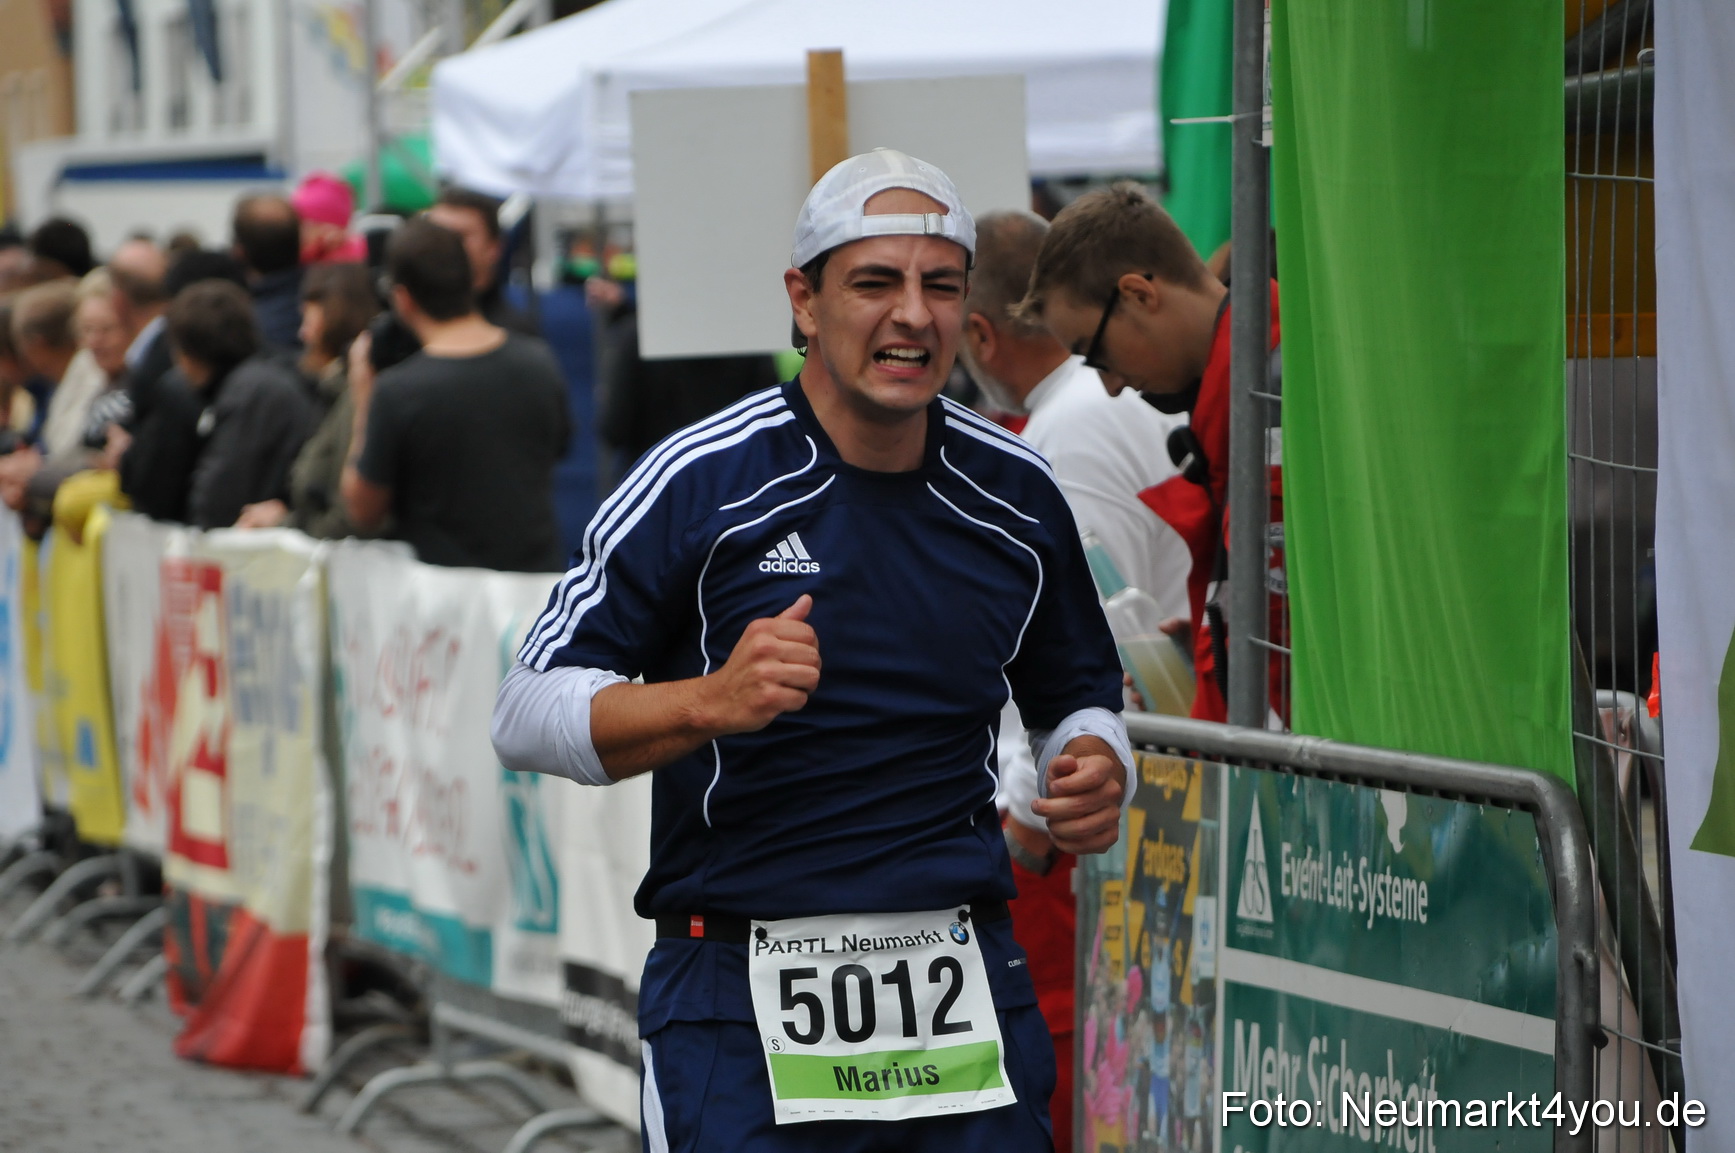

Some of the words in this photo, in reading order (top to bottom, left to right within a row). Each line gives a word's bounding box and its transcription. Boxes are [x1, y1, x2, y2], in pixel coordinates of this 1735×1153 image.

[759, 558, 820, 573] adidas
[755, 937, 835, 956] PARTL
[842, 930, 944, 953] Neumarkt
[778, 955, 974, 1045] 5012
[832, 1062, 940, 1093] Marius
[1233, 1018, 1301, 1118] Mehr
